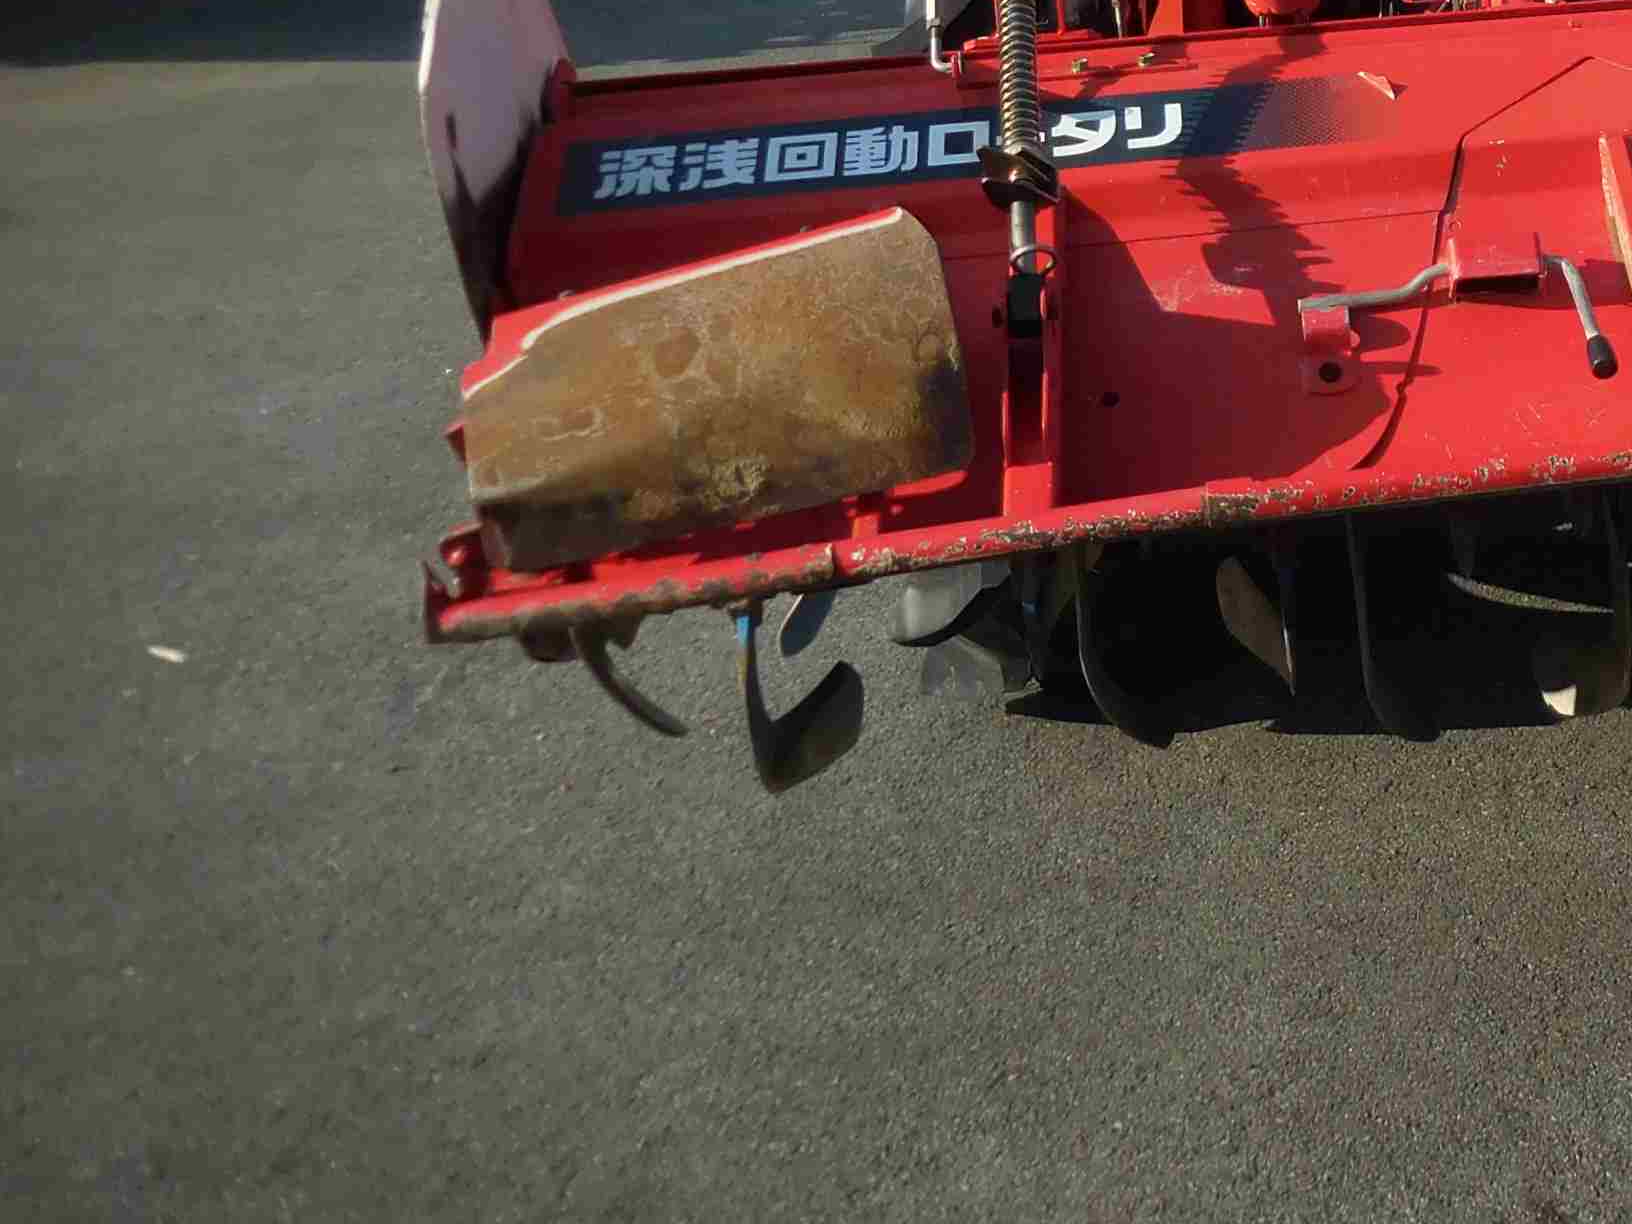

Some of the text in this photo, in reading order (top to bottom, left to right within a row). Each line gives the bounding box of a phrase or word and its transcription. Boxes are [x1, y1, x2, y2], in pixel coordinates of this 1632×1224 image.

[593, 102, 1183, 200] 深浅回動ロタリ
